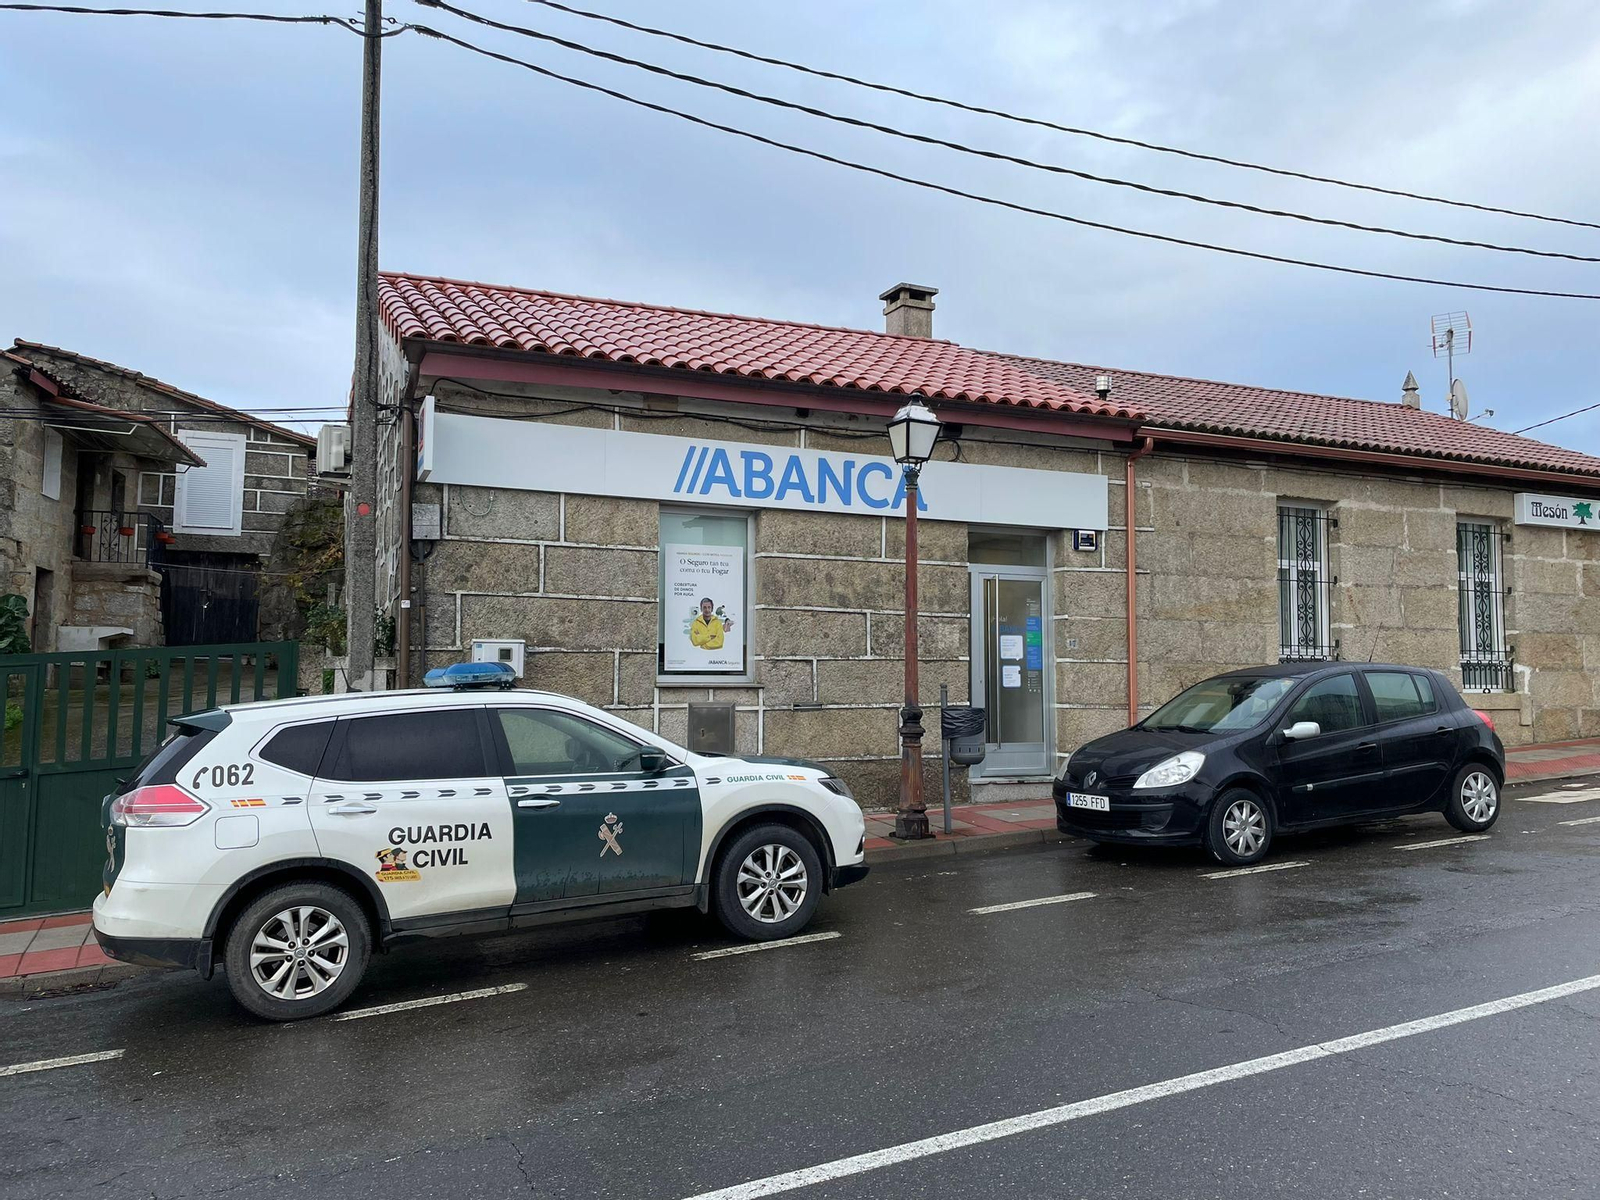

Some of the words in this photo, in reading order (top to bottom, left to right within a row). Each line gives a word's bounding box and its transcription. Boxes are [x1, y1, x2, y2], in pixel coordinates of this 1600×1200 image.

[1531, 502, 1568, 520] Mesón
[687, 559, 709, 567] Seguro
[712, 568, 729, 576] Fogar
[211, 763, 254, 788] 062
[726, 775, 764, 783] GUARDIA
[1072, 795, 1088, 806] 1255
[1091, 797, 1105, 809] FFD
[388, 822, 492, 845] GUARDIA
[412, 848, 468, 868] CIVIL
